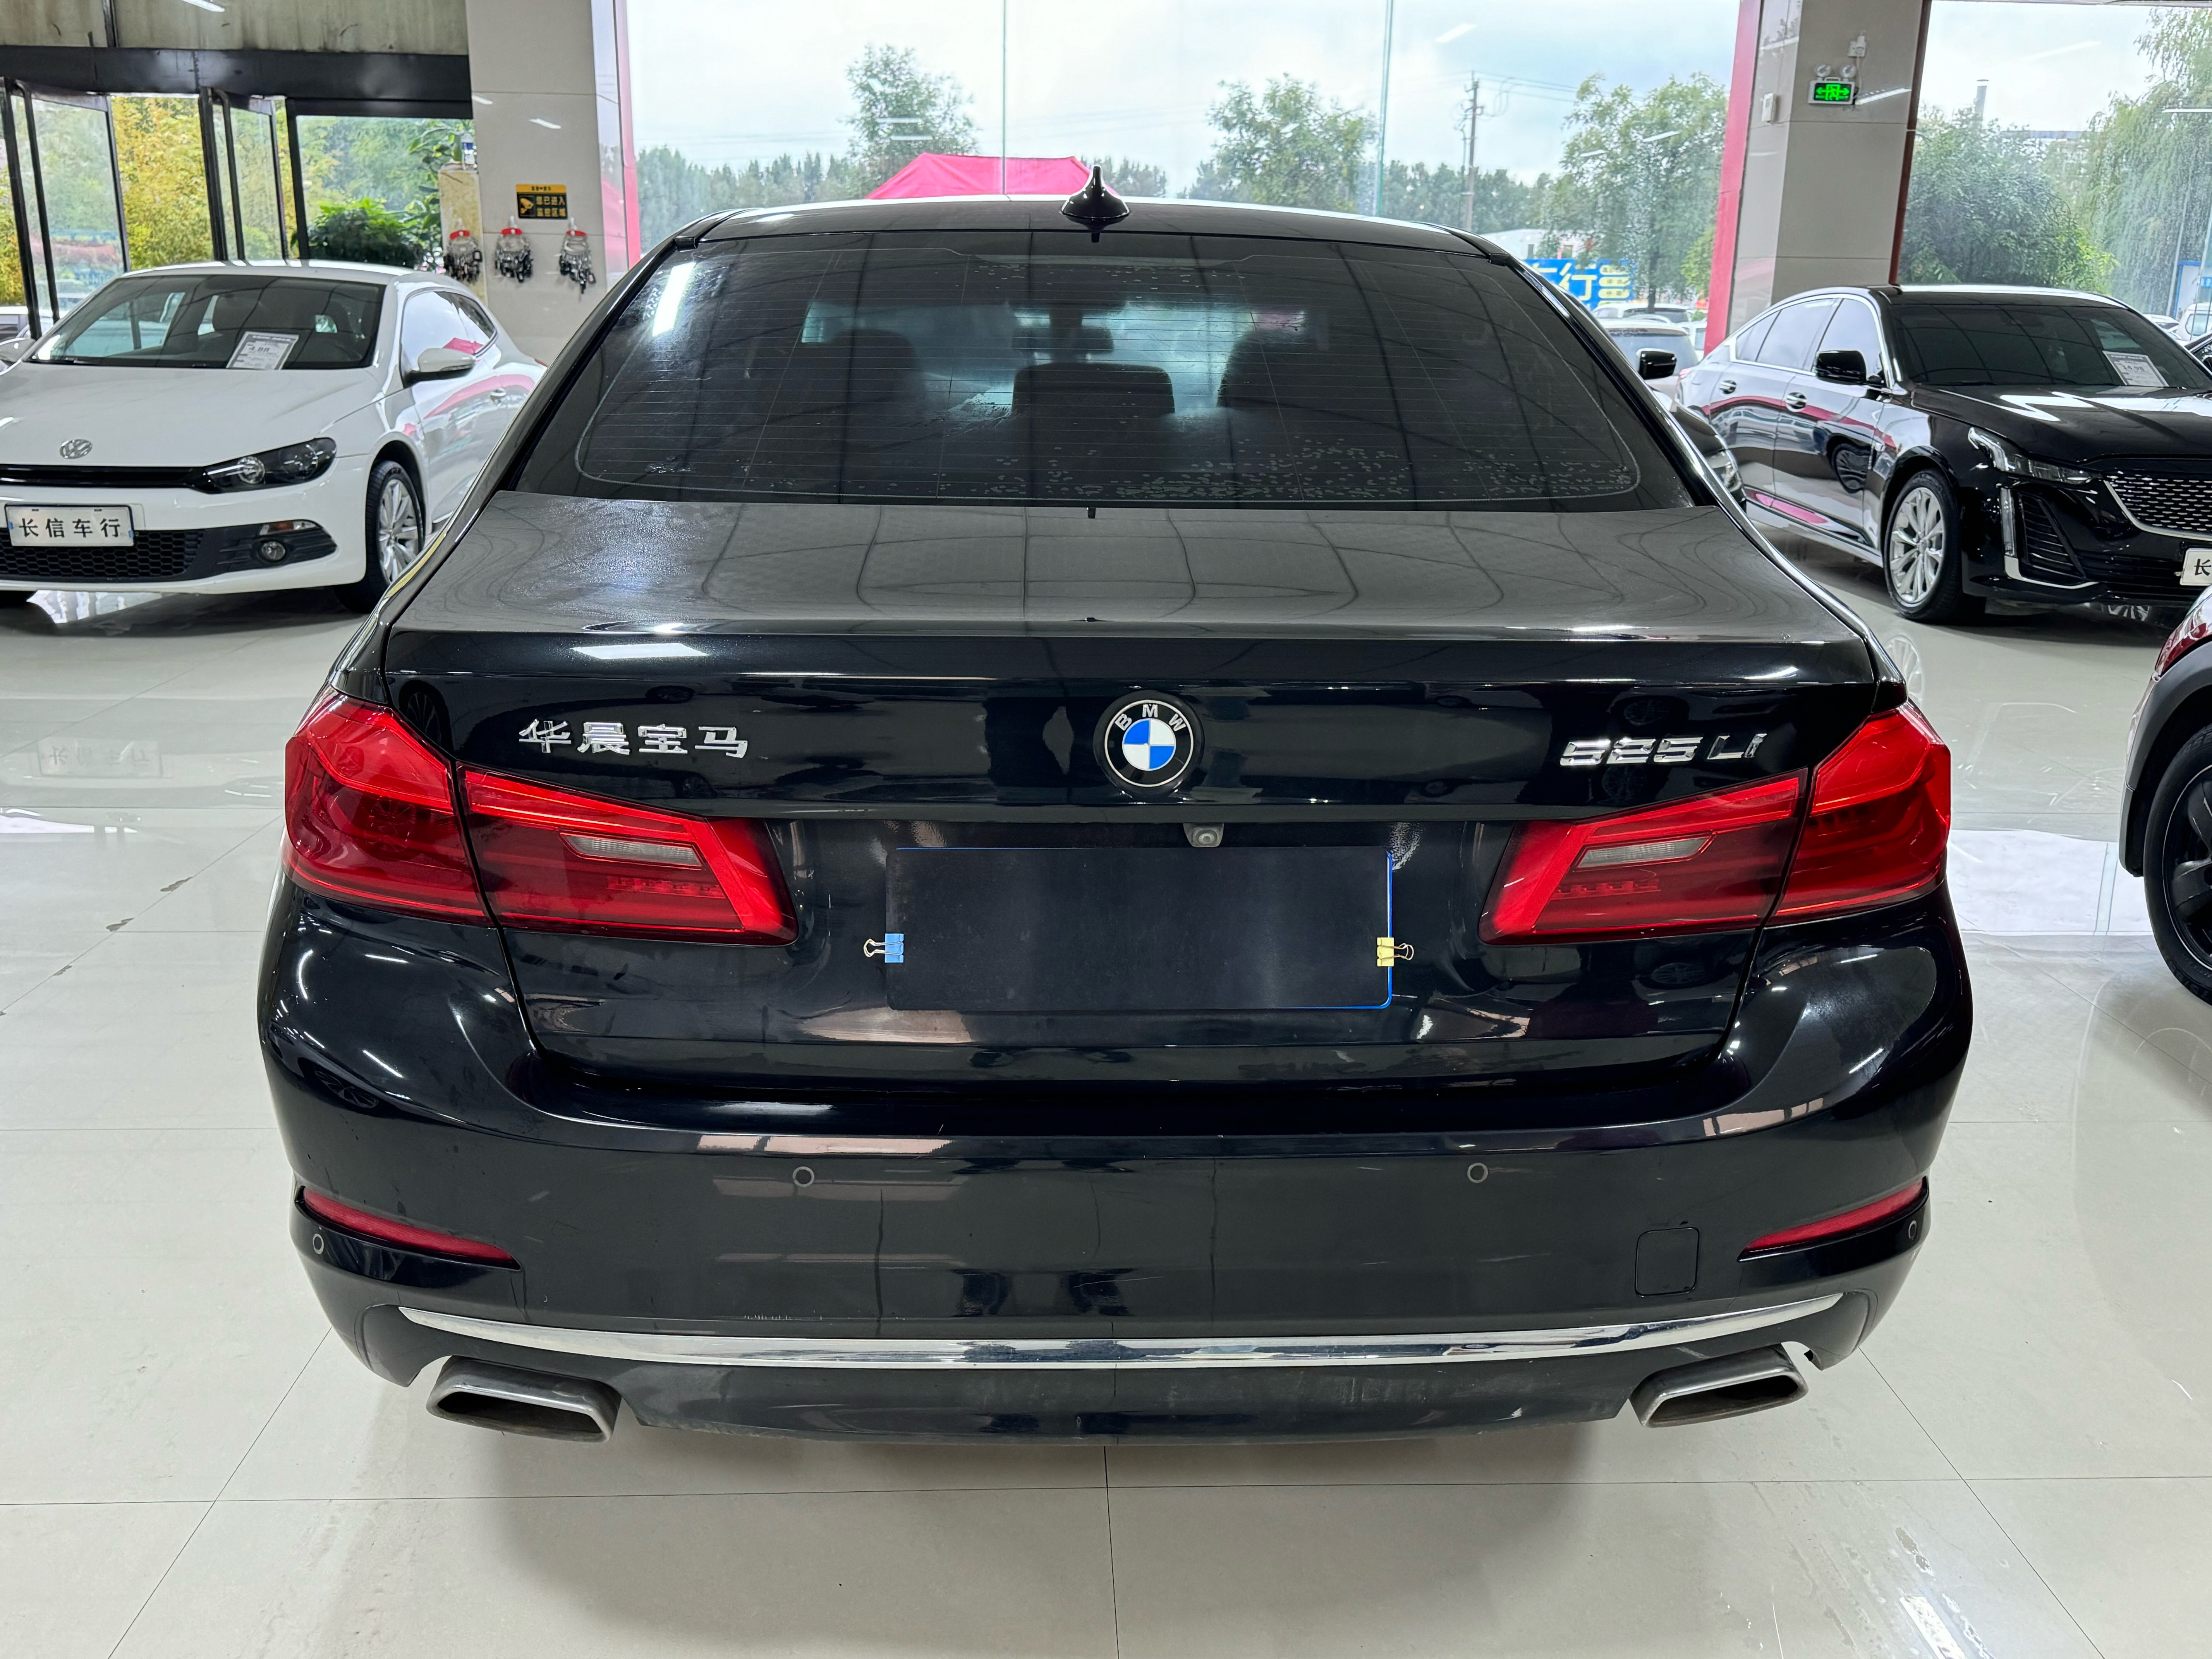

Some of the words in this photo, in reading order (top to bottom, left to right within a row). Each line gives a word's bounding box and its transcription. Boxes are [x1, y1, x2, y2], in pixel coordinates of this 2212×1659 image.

[19, 518, 120, 538] 长信车行
[2194, 558, 2212, 576] 长
[1115, 704, 1186, 732] BMW
[519, 719, 748, 758] 华晨宝马
